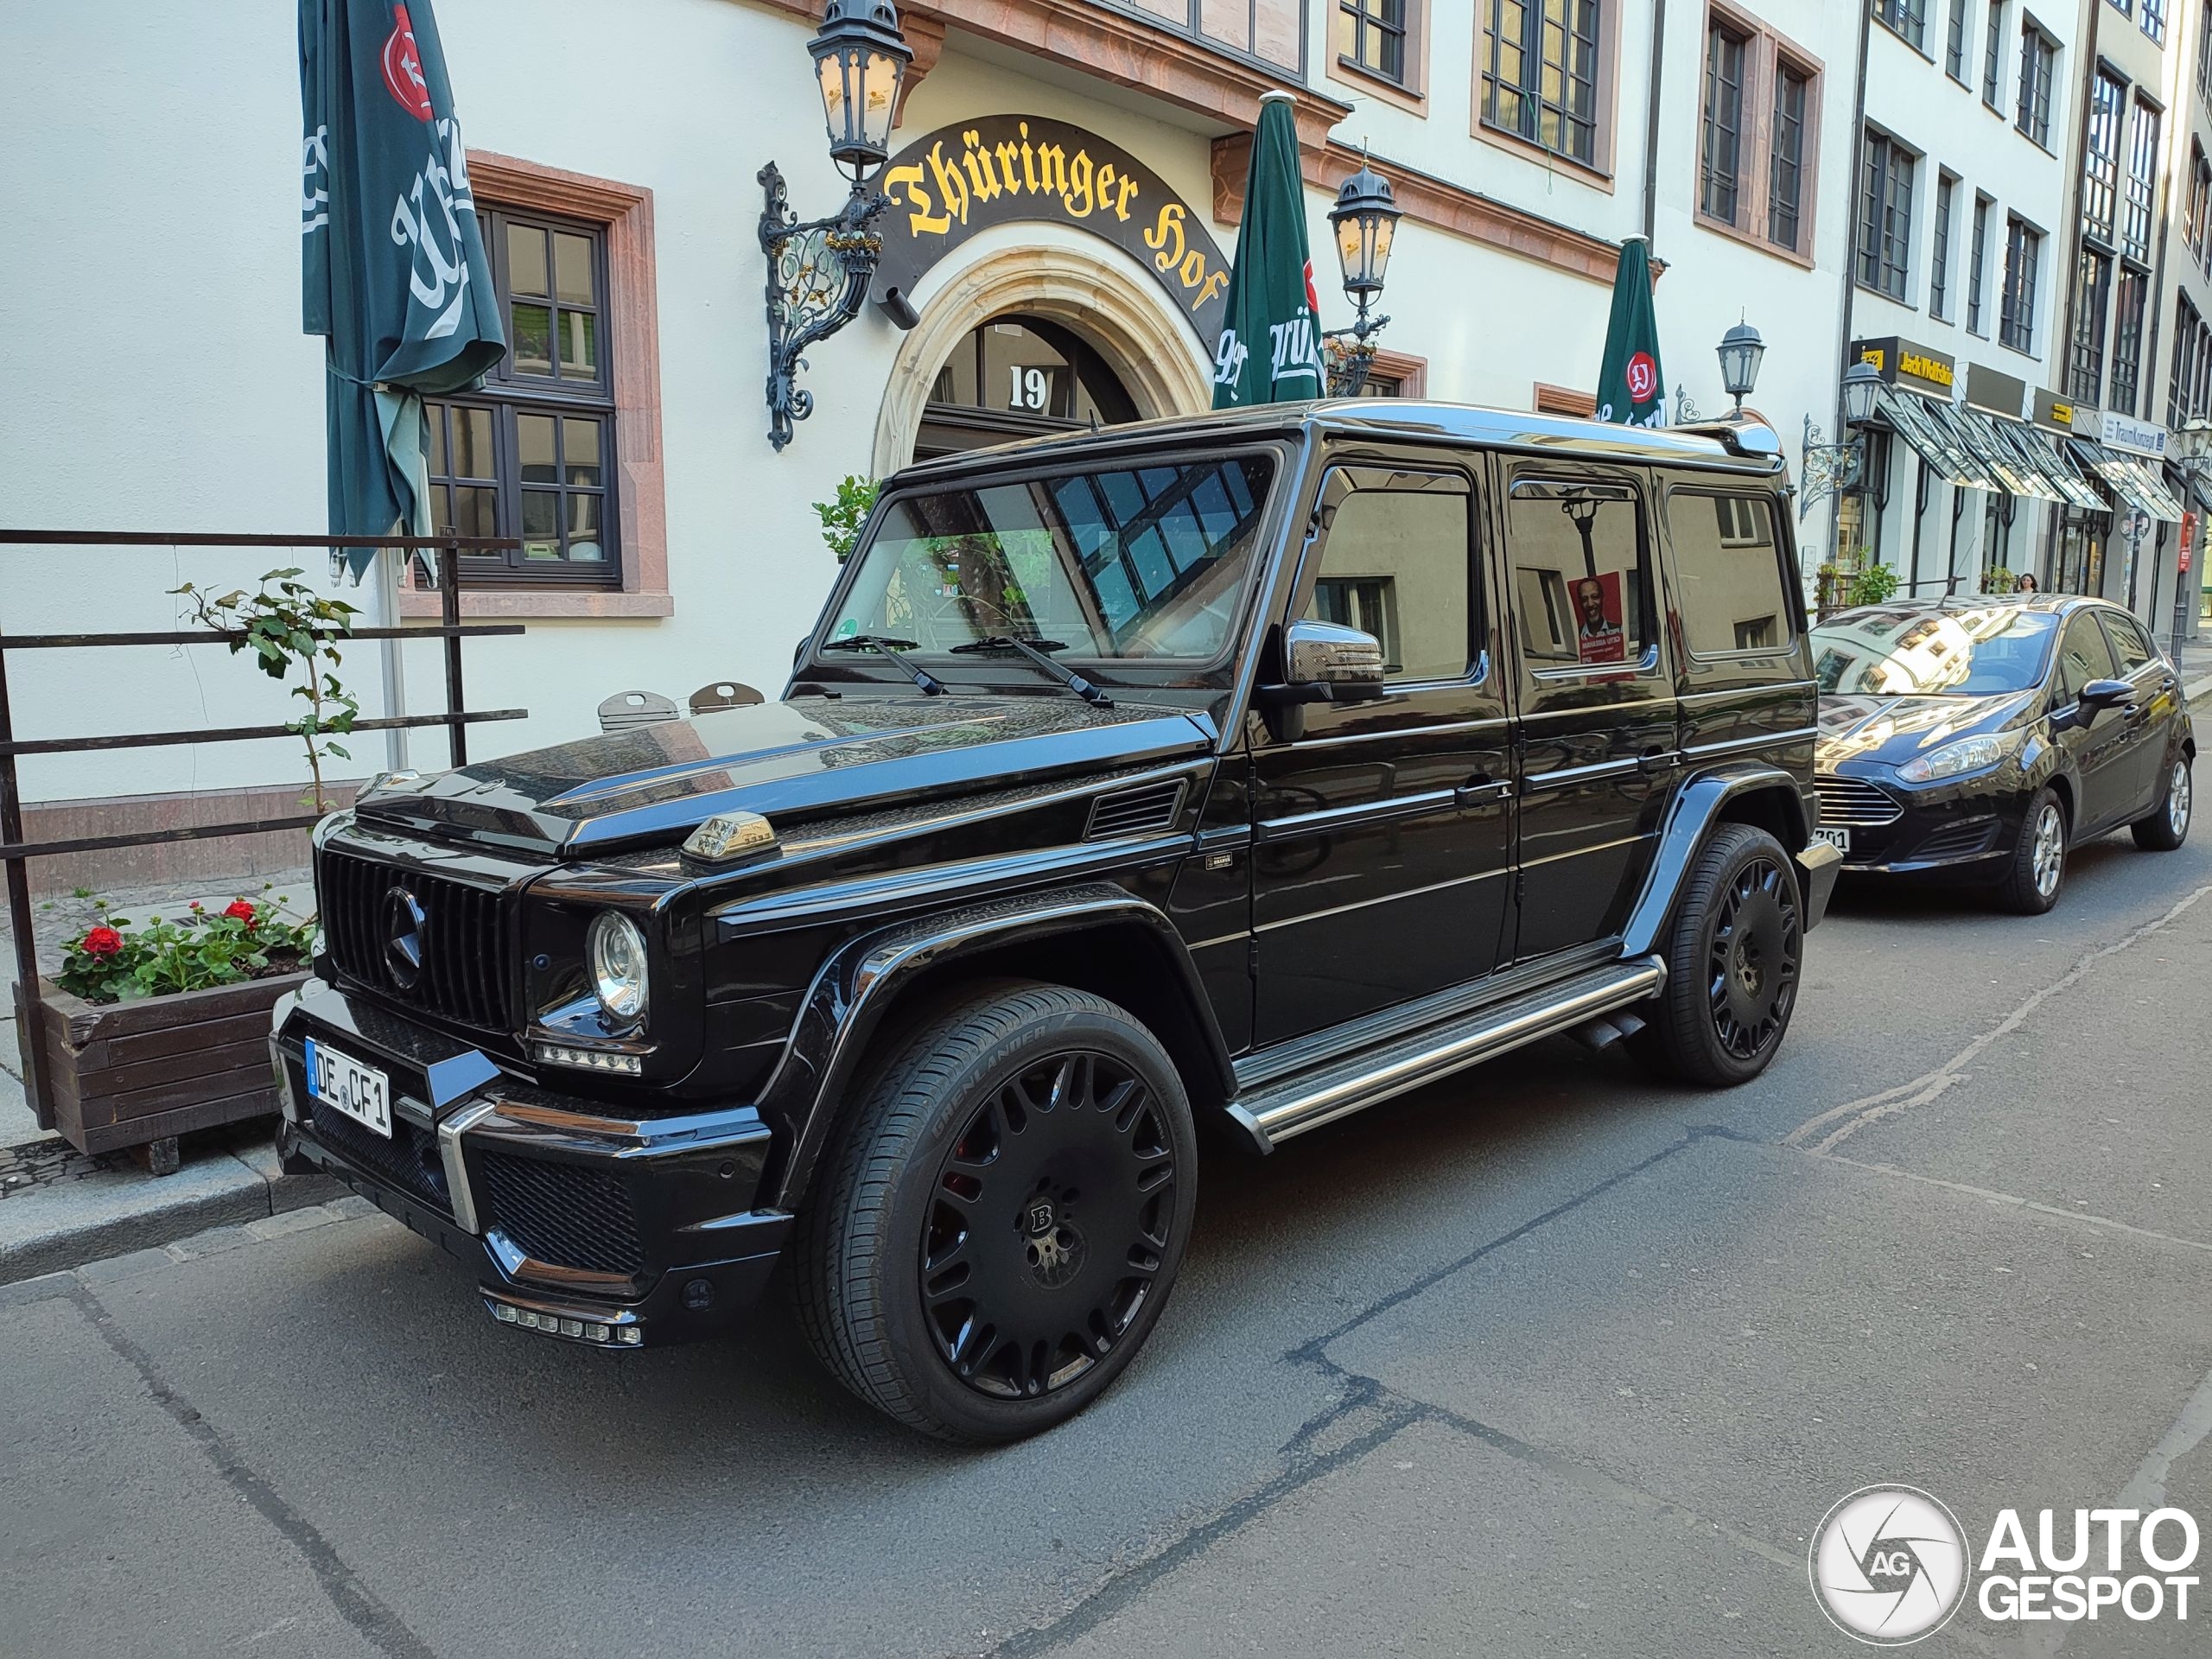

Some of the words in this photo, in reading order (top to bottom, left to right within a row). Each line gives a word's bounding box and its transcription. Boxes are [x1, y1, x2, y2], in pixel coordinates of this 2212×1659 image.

[884, 121, 1138, 238] Thüringer
[1143, 203, 1230, 311] Hof
[1010, 365, 1047, 409] 19
[1900, 351, 1921, 376] Jack
[1921, 356, 1953, 386] Wolfskin
[315, 1052, 338, 1102] DE
[349, 1069, 386, 1128] CF1
